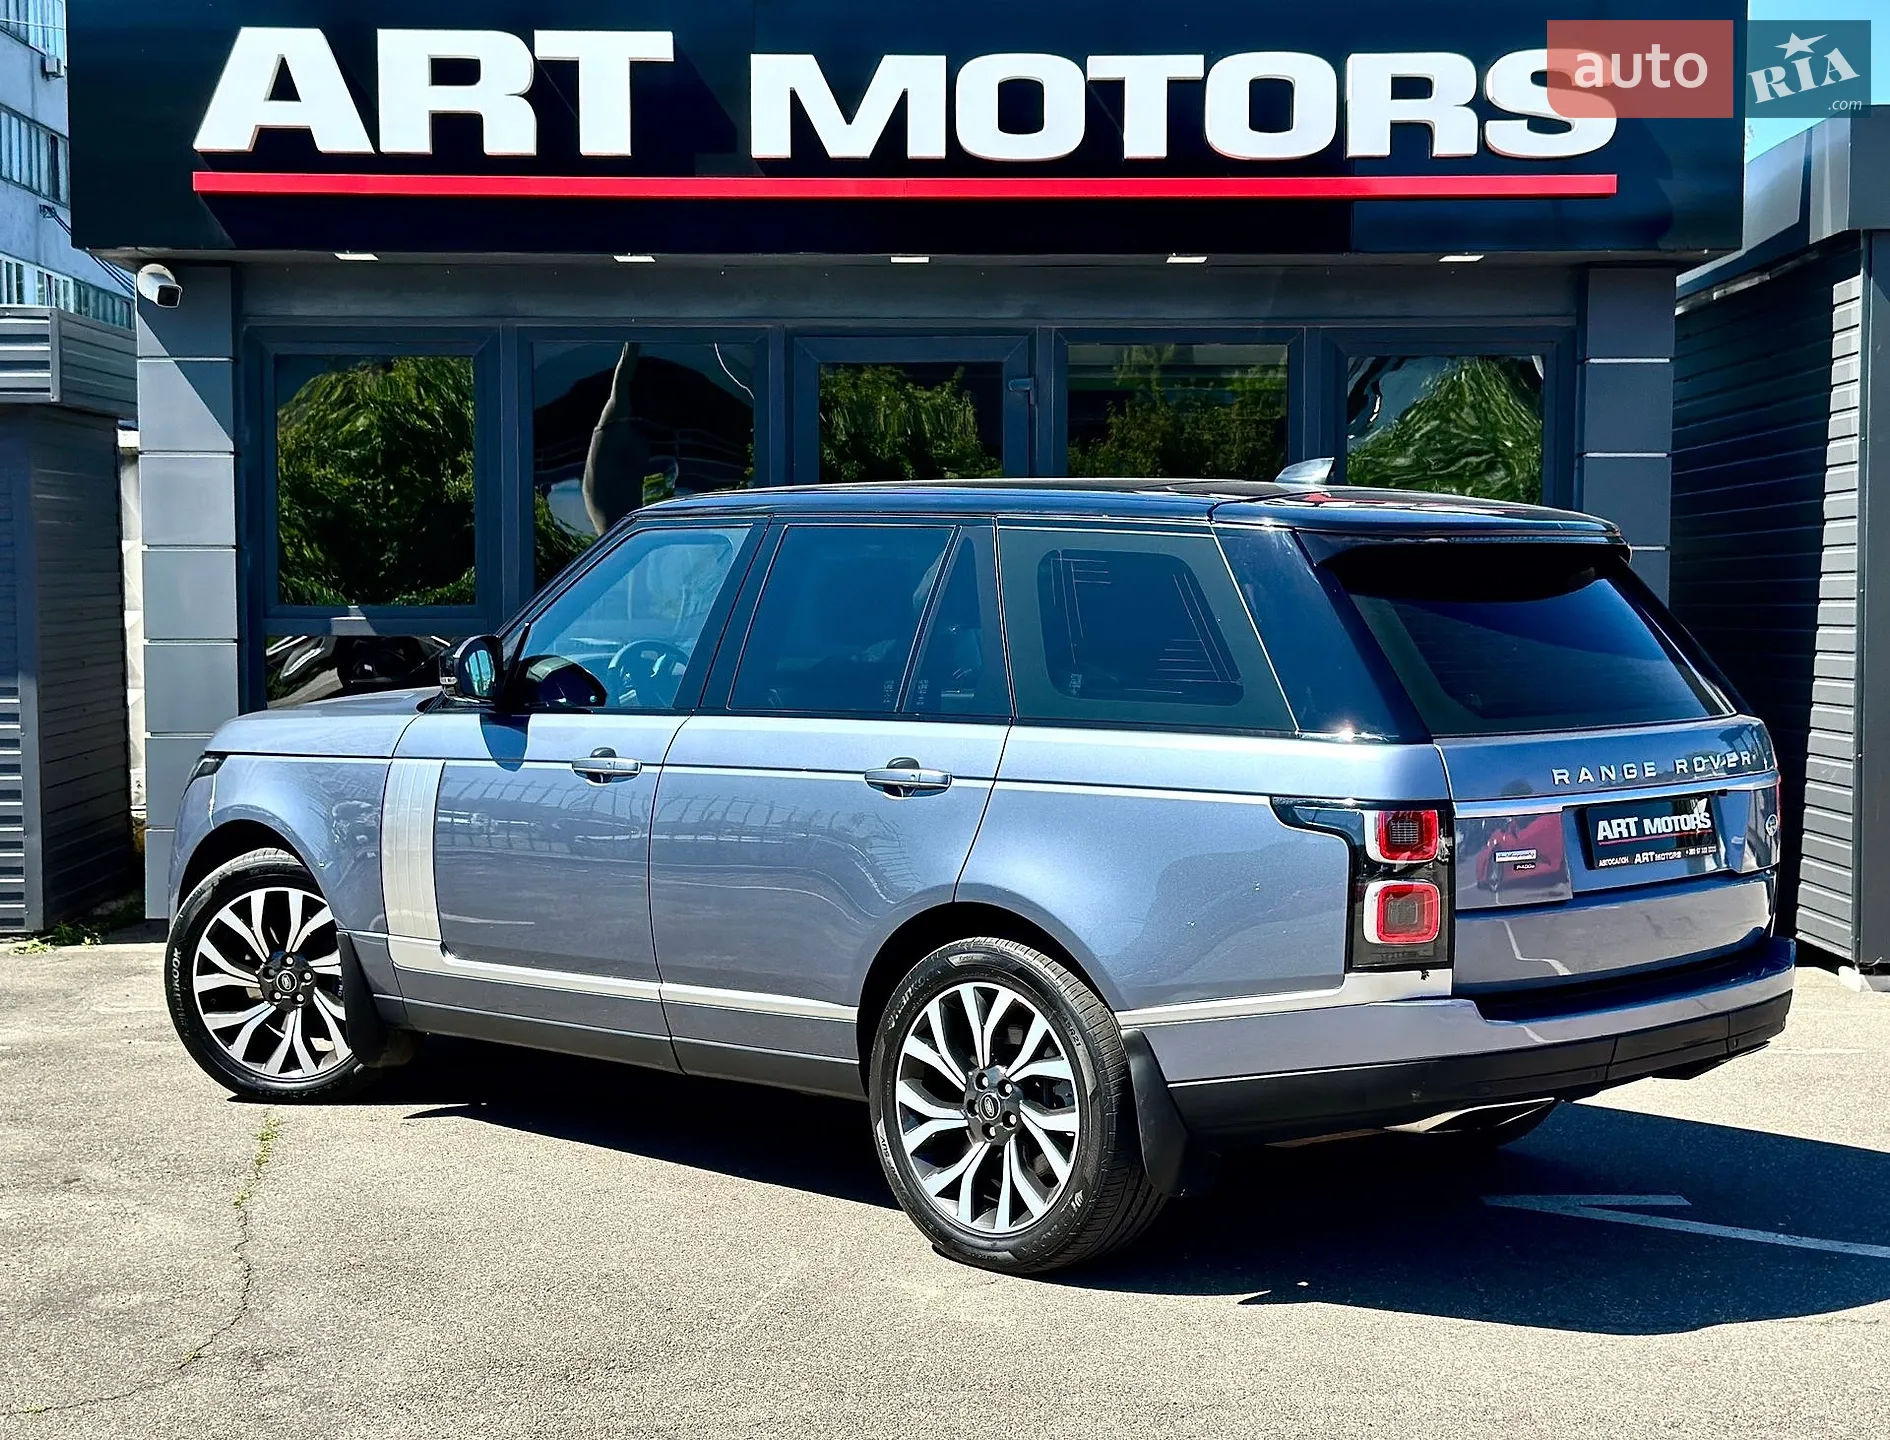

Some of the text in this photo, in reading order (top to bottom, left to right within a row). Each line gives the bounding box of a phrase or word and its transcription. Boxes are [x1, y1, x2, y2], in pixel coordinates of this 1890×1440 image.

[193, 26, 1617, 160] ART MOTORS
[1551, 750, 1752, 785] RANGE ROVER
[1597, 811, 1712, 841] ART MOTORS
[1634, 851, 1655, 864] ART
